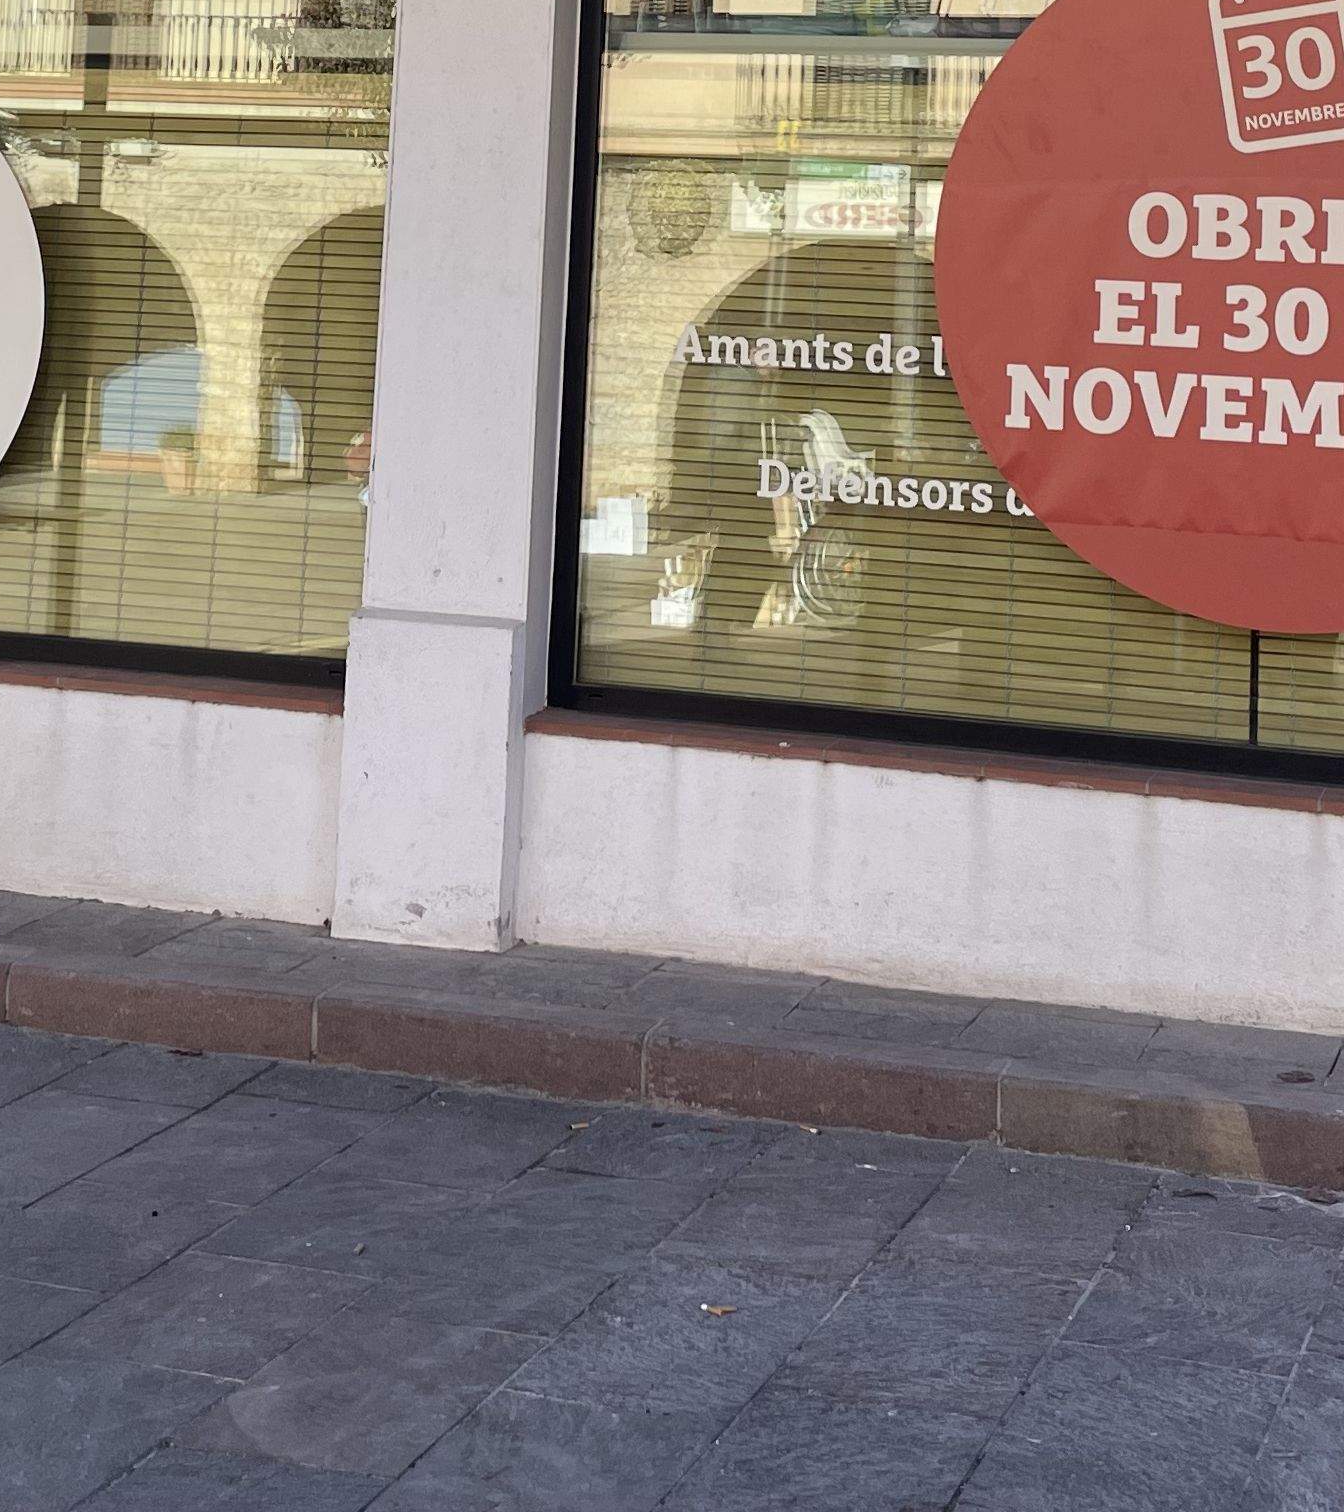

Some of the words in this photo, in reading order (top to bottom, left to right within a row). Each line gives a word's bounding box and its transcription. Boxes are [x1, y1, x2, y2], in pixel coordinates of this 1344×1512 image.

[1237, 26, 1336, 99] 30
[672, 322, 854, 372] Amants
[865, 333, 920, 376] de
[1093, 279, 1200, 349] EL
[1223, 284, 1330, 356] 30
[757, 459, 994, 514] Defensors
